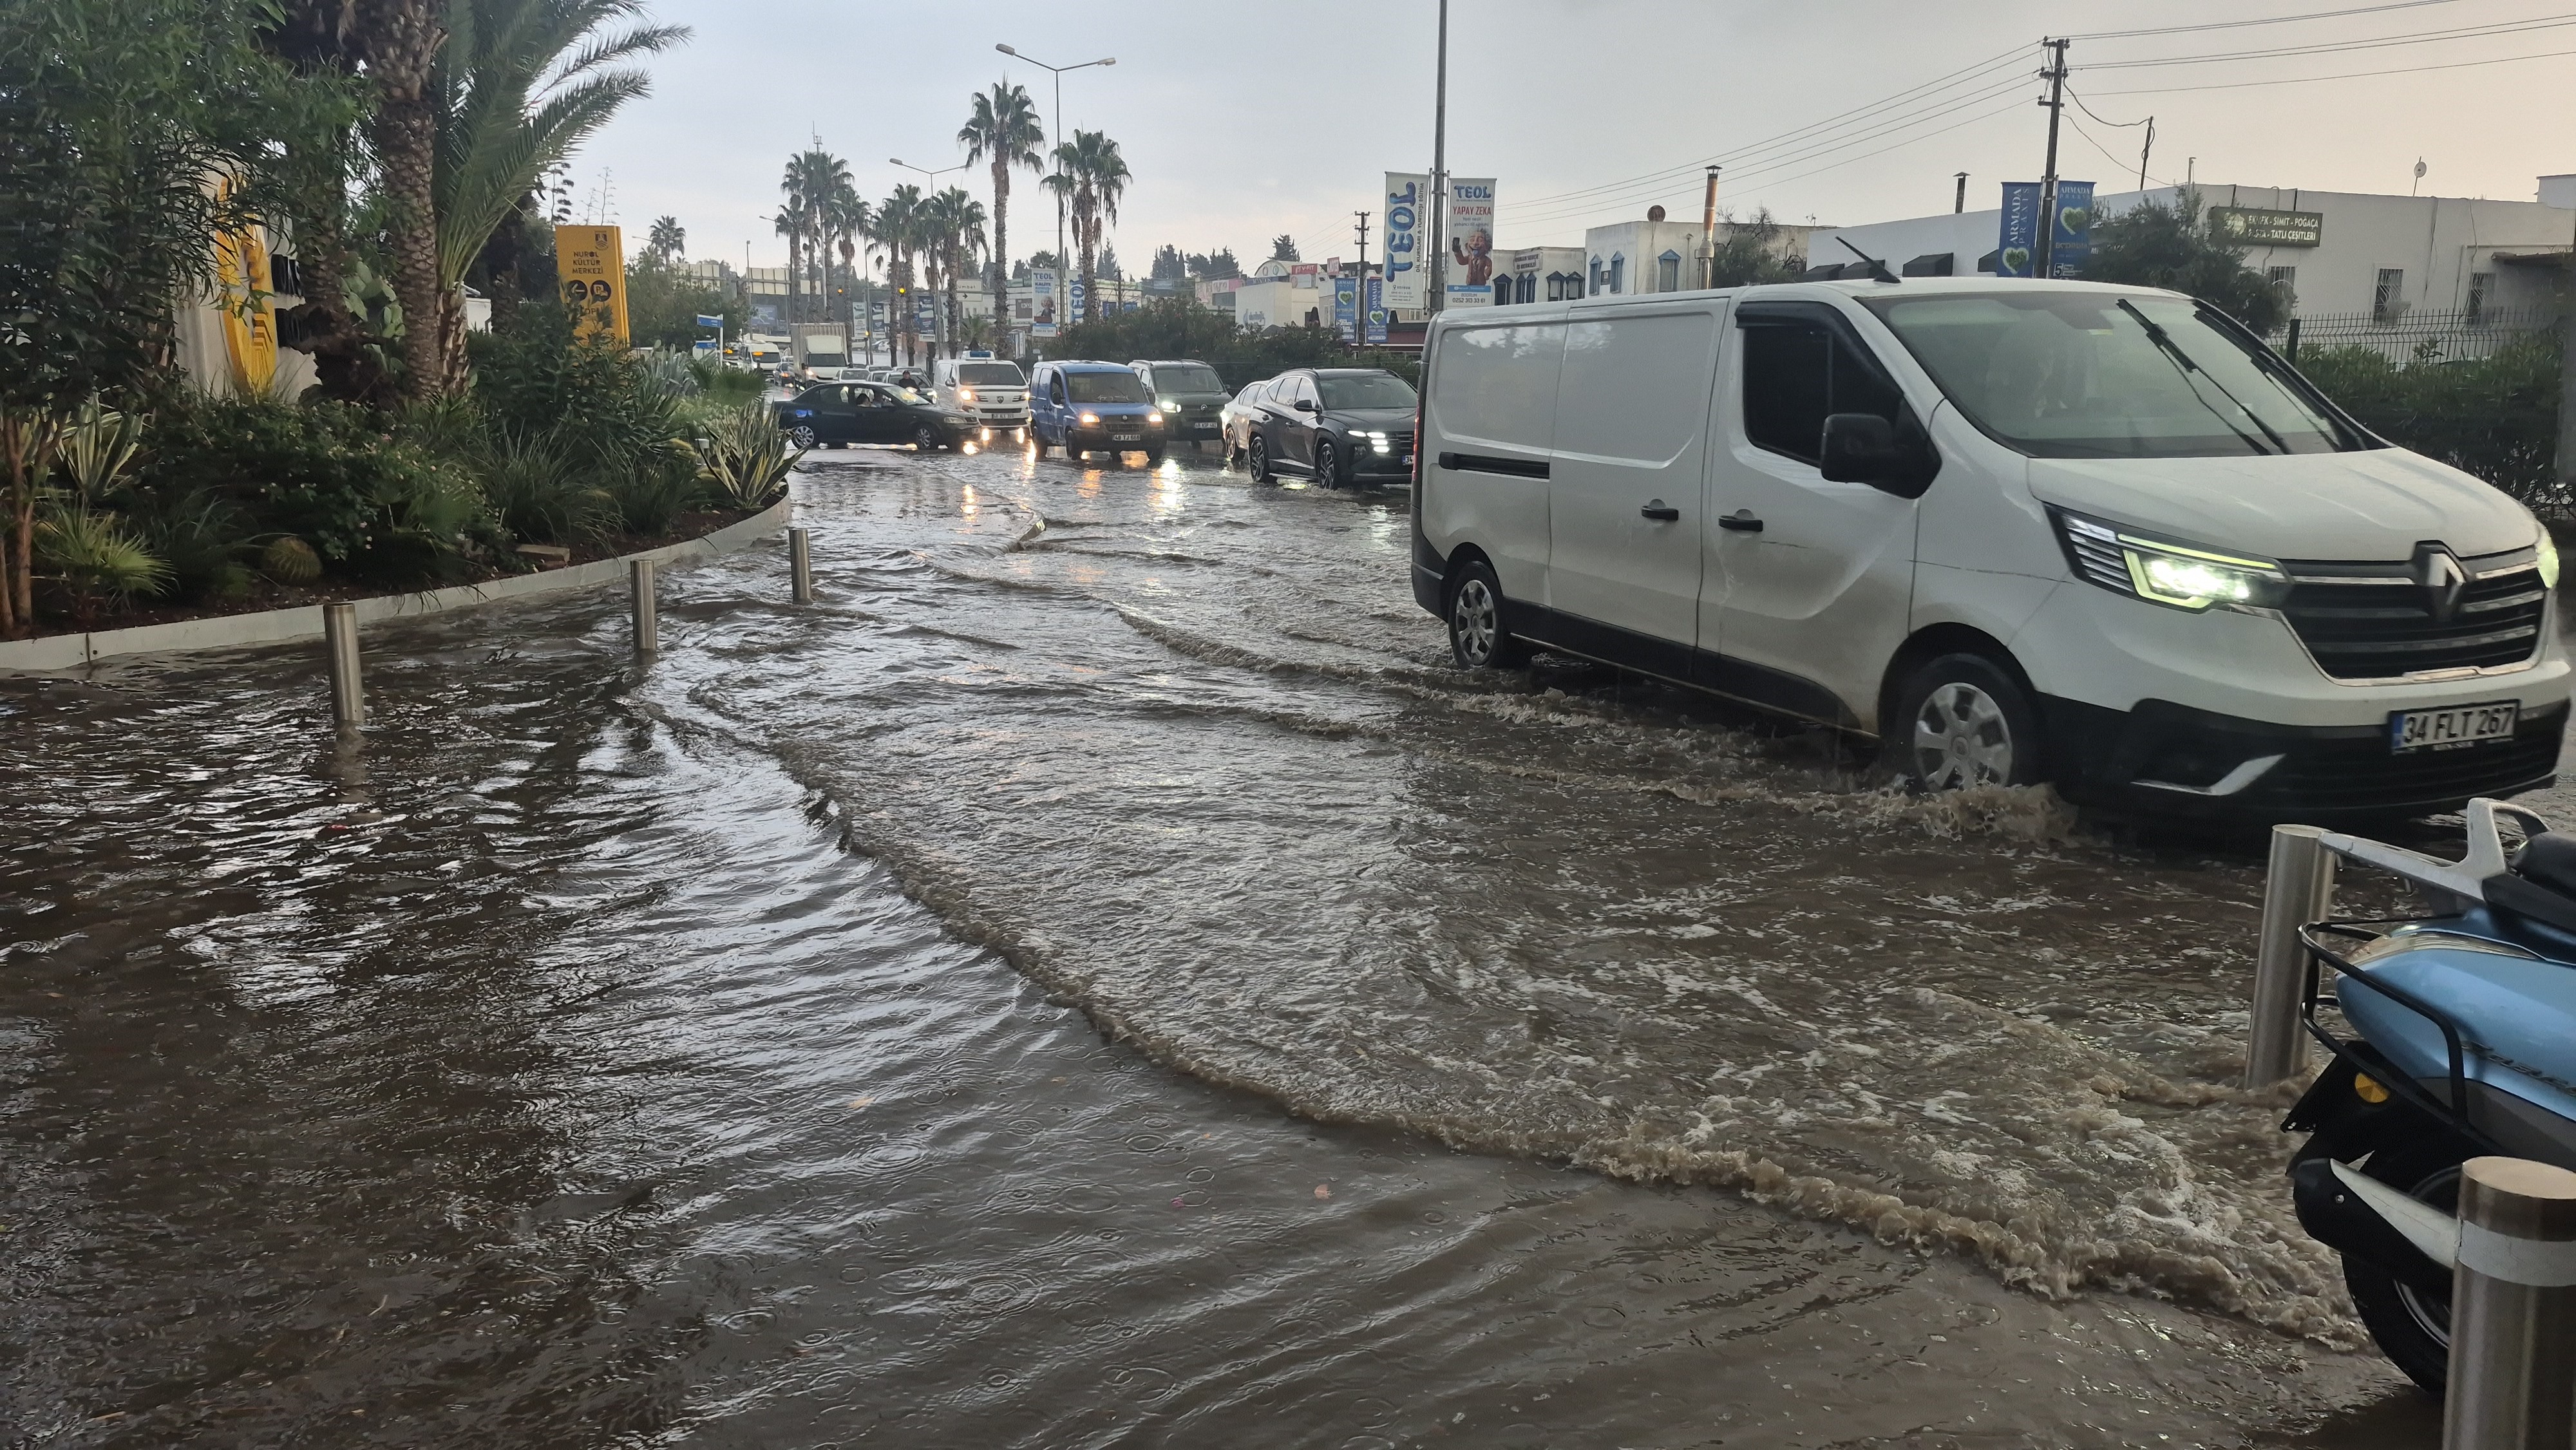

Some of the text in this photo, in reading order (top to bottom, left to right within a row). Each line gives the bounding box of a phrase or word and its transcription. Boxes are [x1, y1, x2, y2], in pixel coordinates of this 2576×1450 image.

[1454, 185, 1492, 198] TEOL
[1453, 206, 1492, 215] YAPAY ZEKA
[2009, 188, 2022, 244] ARMADA
[2294, 216, 2318, 229] POĞAÇA
[1386, 182, 1416, 282] TEOL
[2271, 229, 2287, 239] TATLI
[2287, 229, 2316, 242] ÇEŞİTLERİ
[573, 258, 601, 266] KÜLTÜR
[572, 266, 604, 274] MERKEZİ
[1069, 274, 1085, 324] TEOL
[2403, 706, 2514, 743] 34 FLT 267
